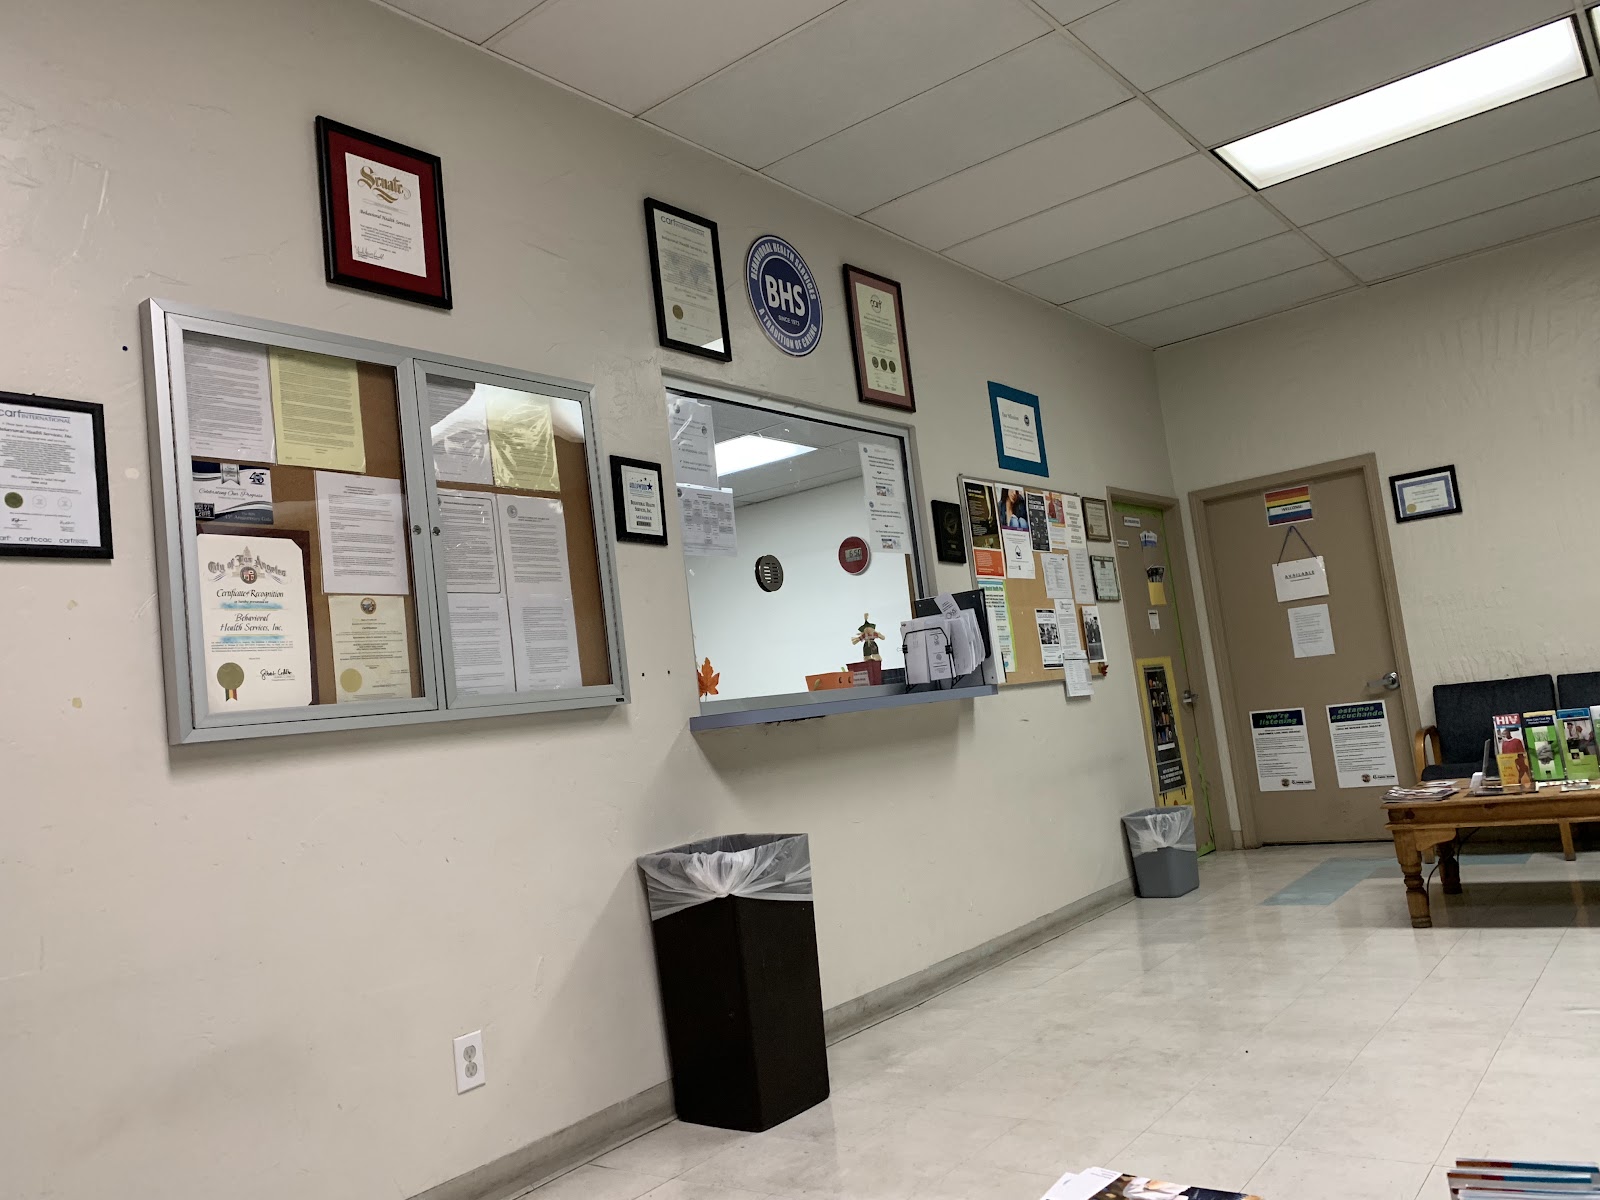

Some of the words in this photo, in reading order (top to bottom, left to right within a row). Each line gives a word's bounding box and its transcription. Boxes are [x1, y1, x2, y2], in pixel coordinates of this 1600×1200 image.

[794, 258, 817, 300] SERVICES
[764, 274, 806, 317] BHS
[763, 314, 794, 349] TRADITION
[207, 561, 226, 574] City
[254, 555, 287, 577] Angeles
[1284, 570, 1315, 580] AVAILABLE
[250, 589, 284, 598] Recognition
[234, 613, 270, 622] Behavioral
[220, 623, 243, 632] Health
[244, 623, 270, 632] Services,
[272, 623, 283, 632] Inc.
[1331, 710, 1383, 720] escuchando
[1337, 706, 1375, 714] estamos
[1260, 718, 1298, 726] listening
[1495, 715, 1518, 725] HIV
